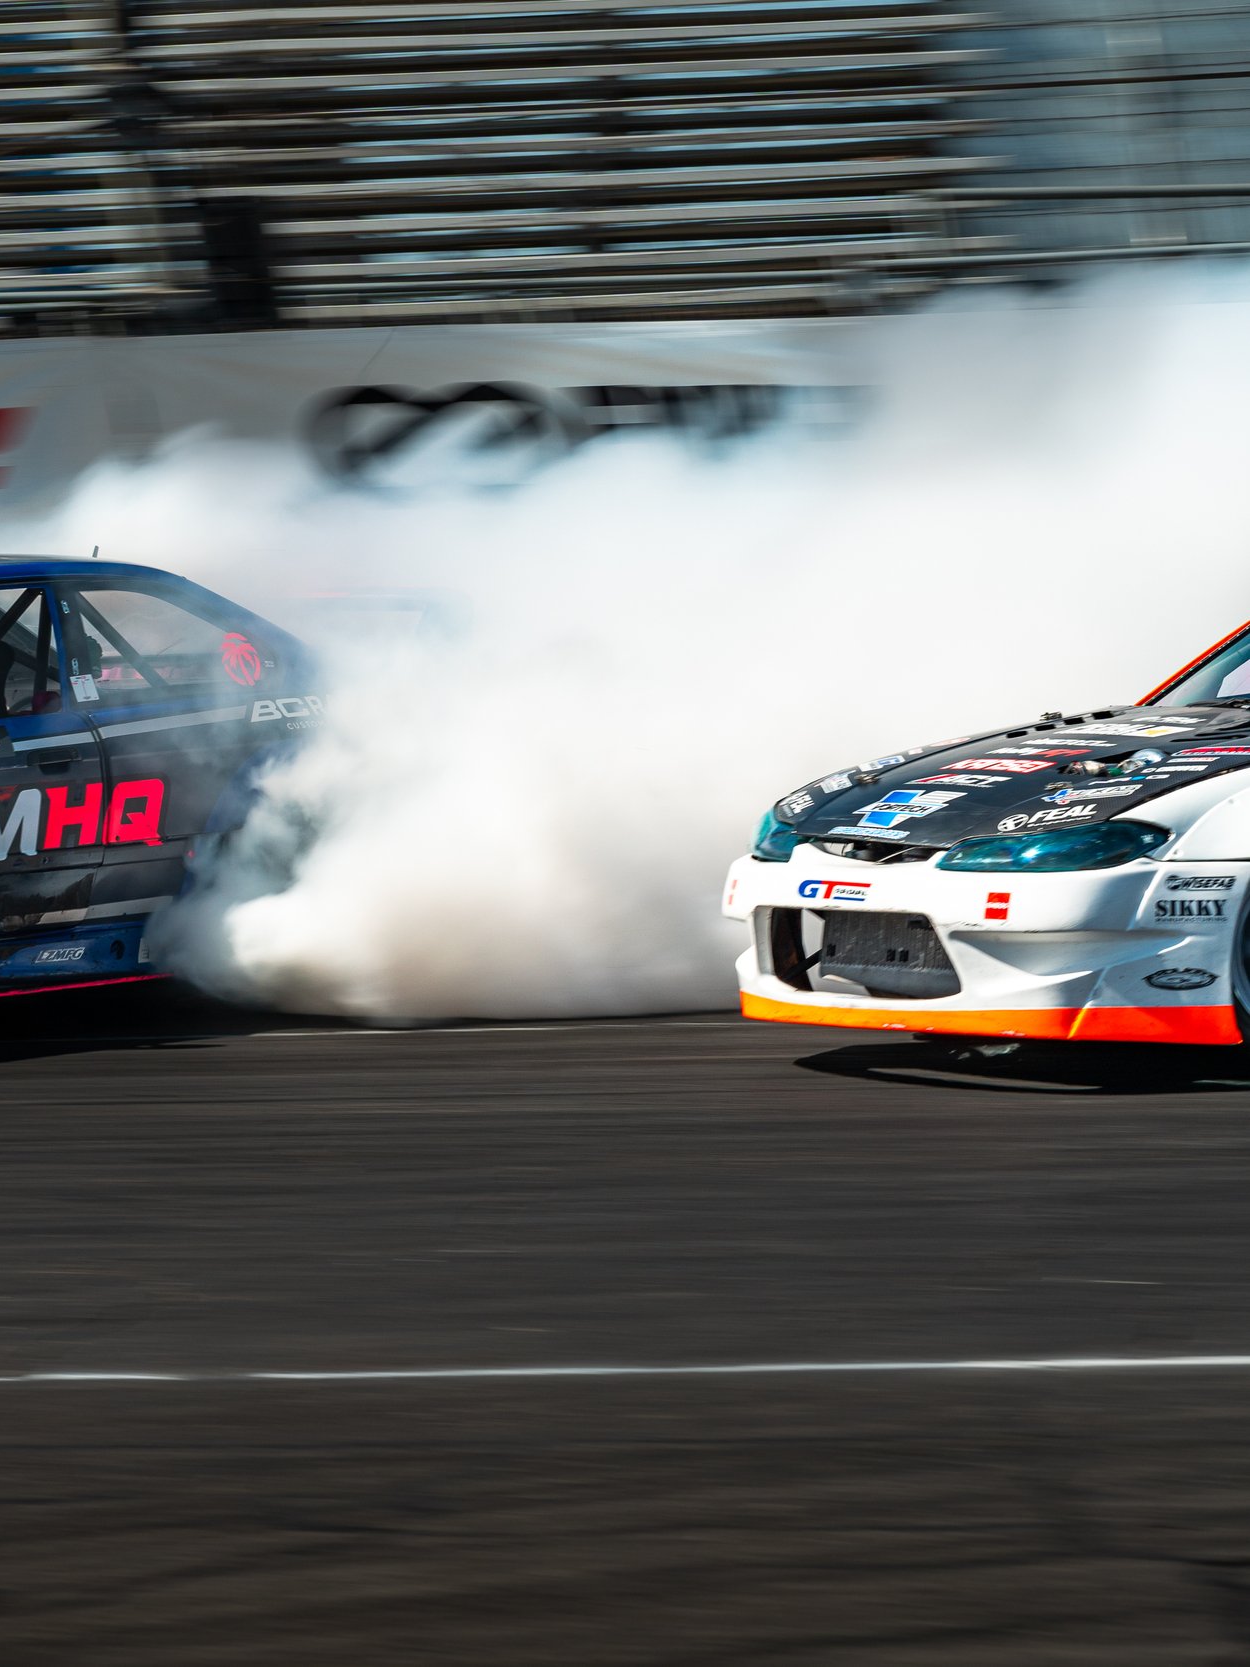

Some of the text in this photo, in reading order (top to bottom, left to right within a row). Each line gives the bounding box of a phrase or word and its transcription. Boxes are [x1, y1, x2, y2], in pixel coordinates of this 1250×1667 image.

[872, 803, 932, 814] VORTECH
[1028, 803, 1098, 824] FEAL
[798, 879, 872, 899] GT
[1155, 899, 1227, 917] SIKKY
